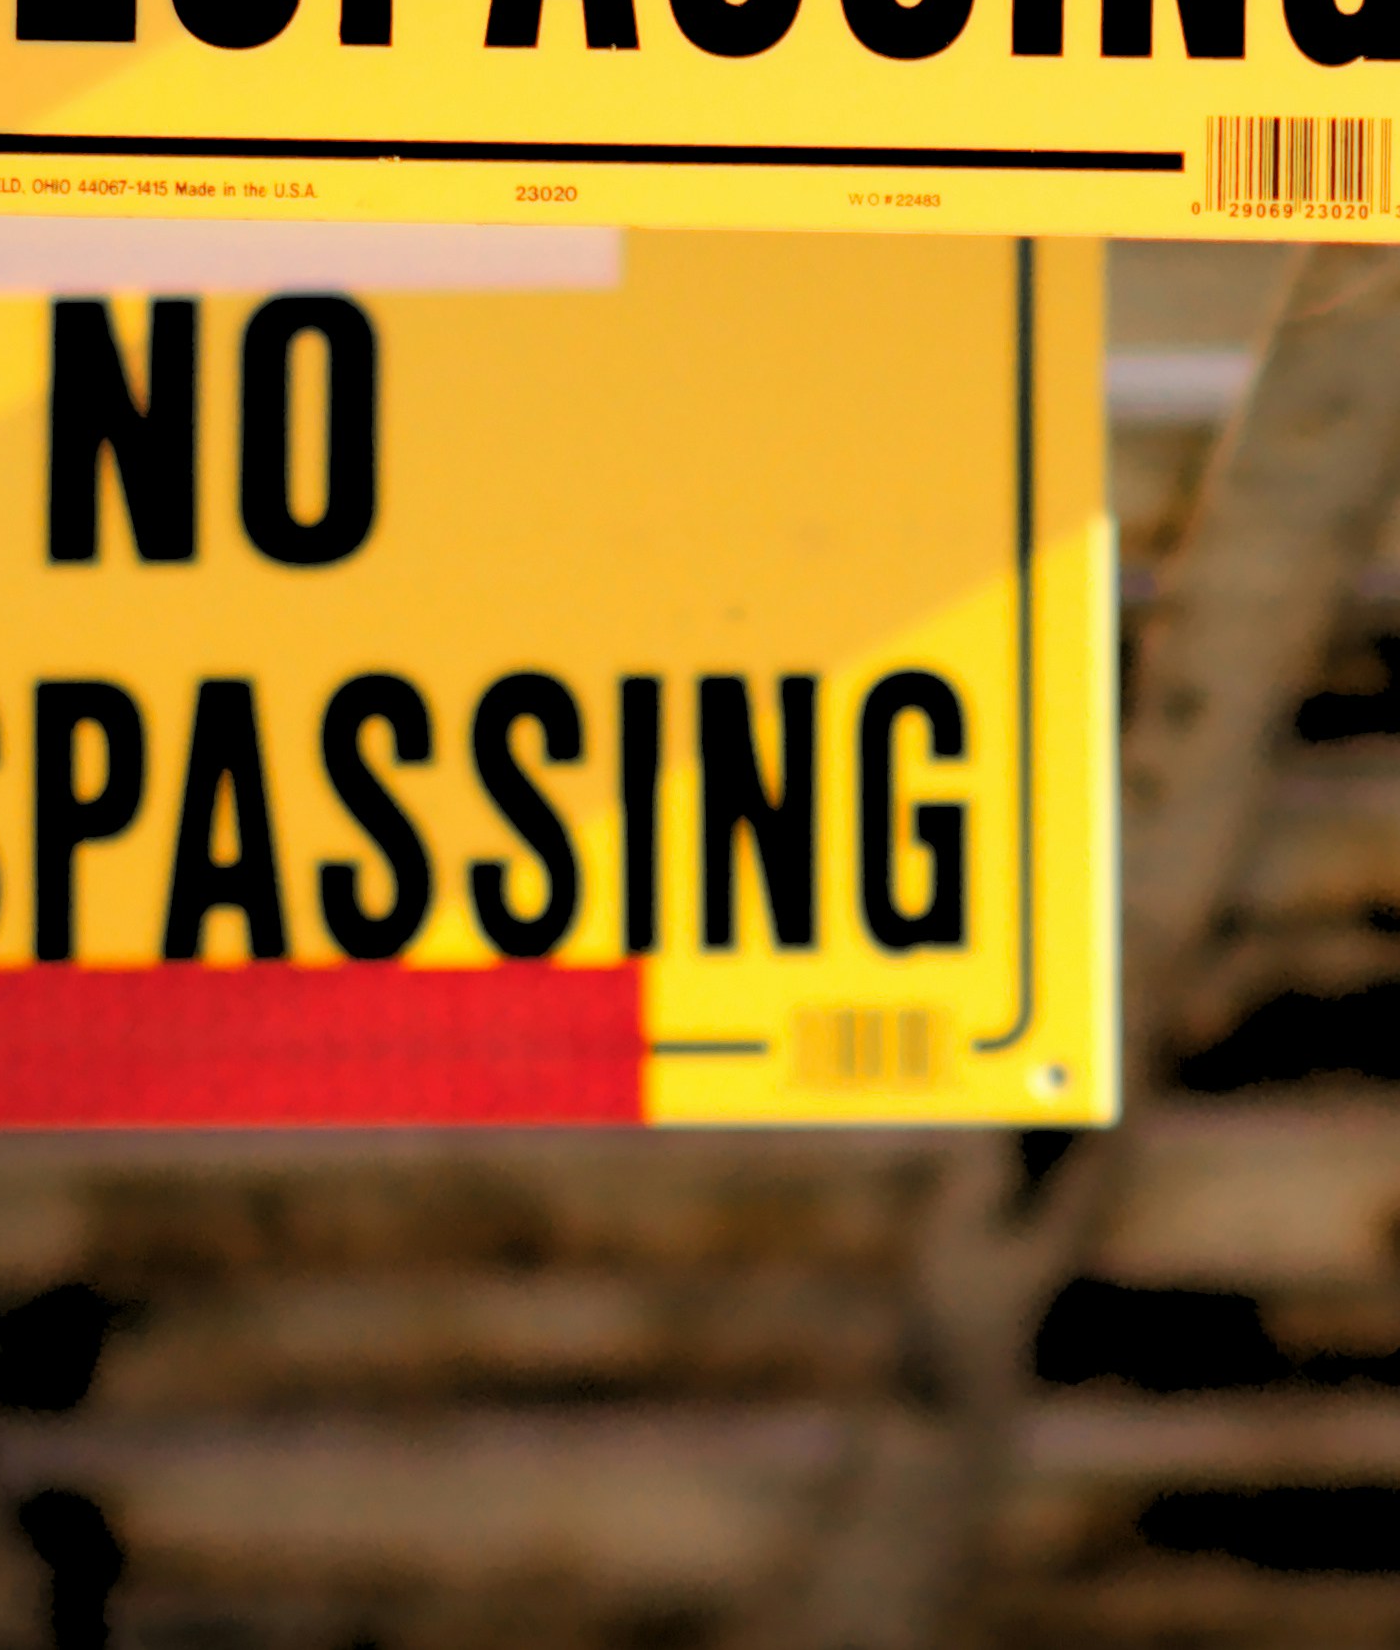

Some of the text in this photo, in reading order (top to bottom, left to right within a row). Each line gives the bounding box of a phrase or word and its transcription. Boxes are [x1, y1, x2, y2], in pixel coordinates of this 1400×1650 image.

[32, 178, 72, 194] OHIO
[77, 179, 168, 196] 44067-1415
[175, 181, 216, 197] Made
[223, 182, 236, 197] in
[243, 182, 266, 198] the
[515, 185, 578, 202] 23020
[1191, 201, 1201, 216] 0
[1229, 202, 1294, 219] 29069
[1305, 203, 1369, 220] 23020
[46, 290, 380, 570] NO
